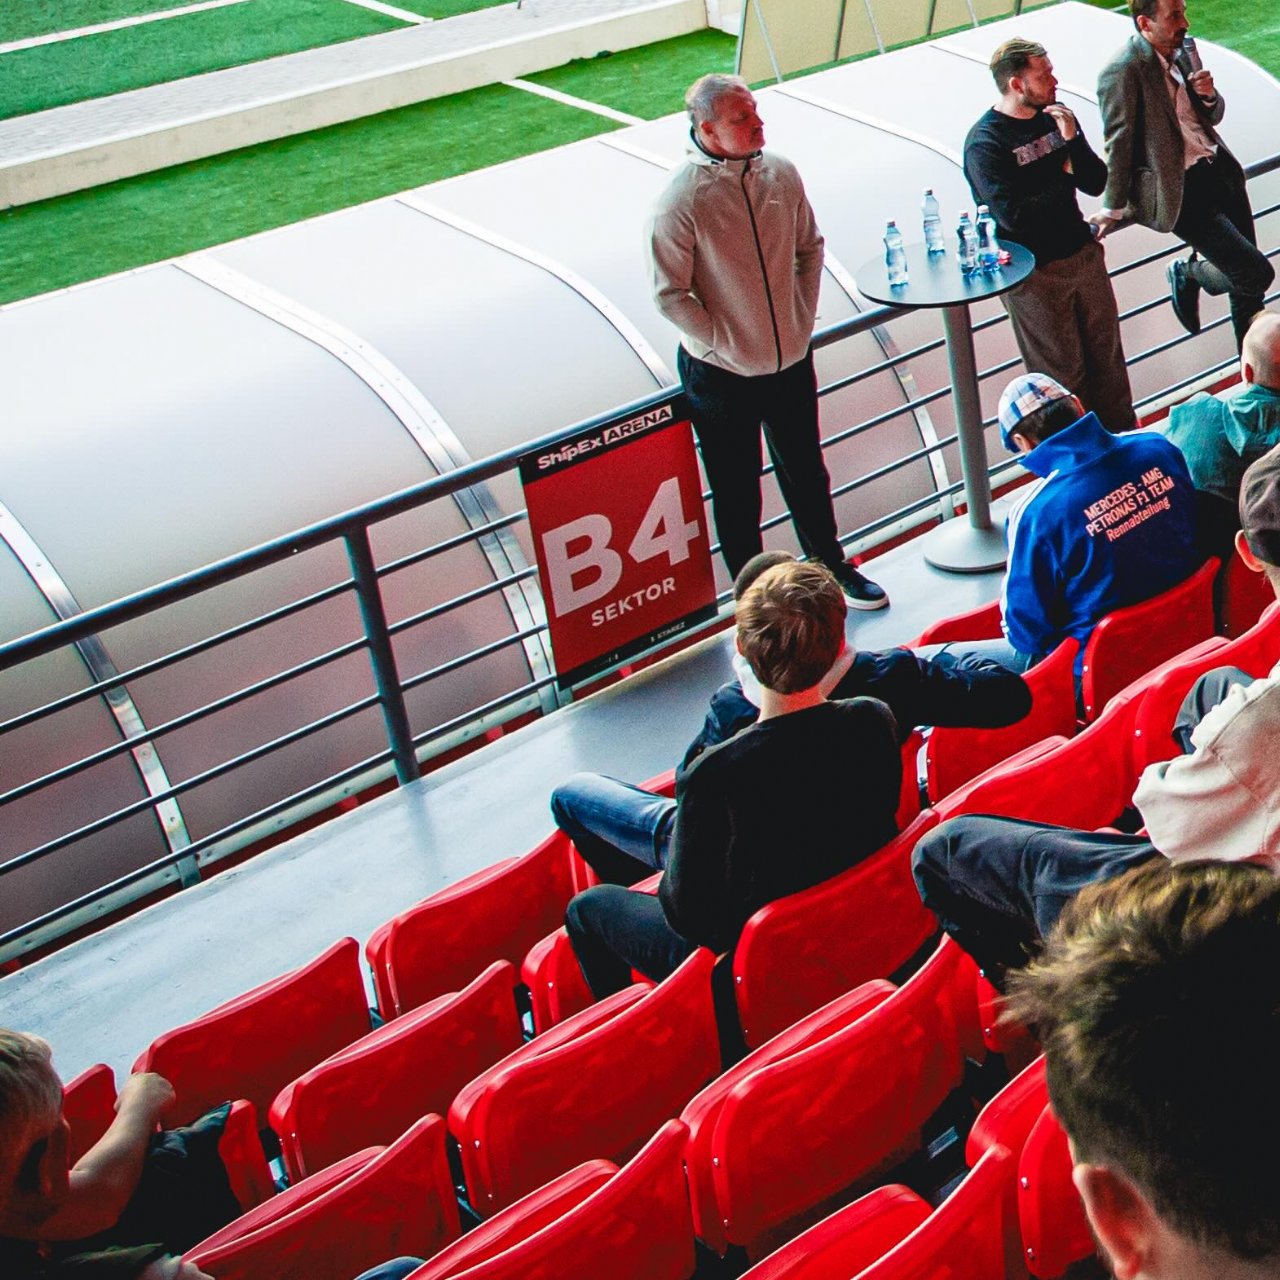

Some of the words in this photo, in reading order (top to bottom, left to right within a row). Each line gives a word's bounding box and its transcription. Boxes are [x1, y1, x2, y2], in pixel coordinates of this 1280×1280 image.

[537, 436, 603, 470] ShipEx
[605, 406, 672, 443] ARENA
[1084, 481, 1137, 521] MERCEDES
[1141, 467, 1163, 488] AMG
[1085, 500, 1138, 537] PETRONAS
[1136, 490, 1151, 507] F1
[1148, 476, 1175, 498] TEAM
[1105, 496, 1172, 542] Rennabteilung
[541, 476, 701, 619] B4
[591, 576, 677, 627] SEKTOR
